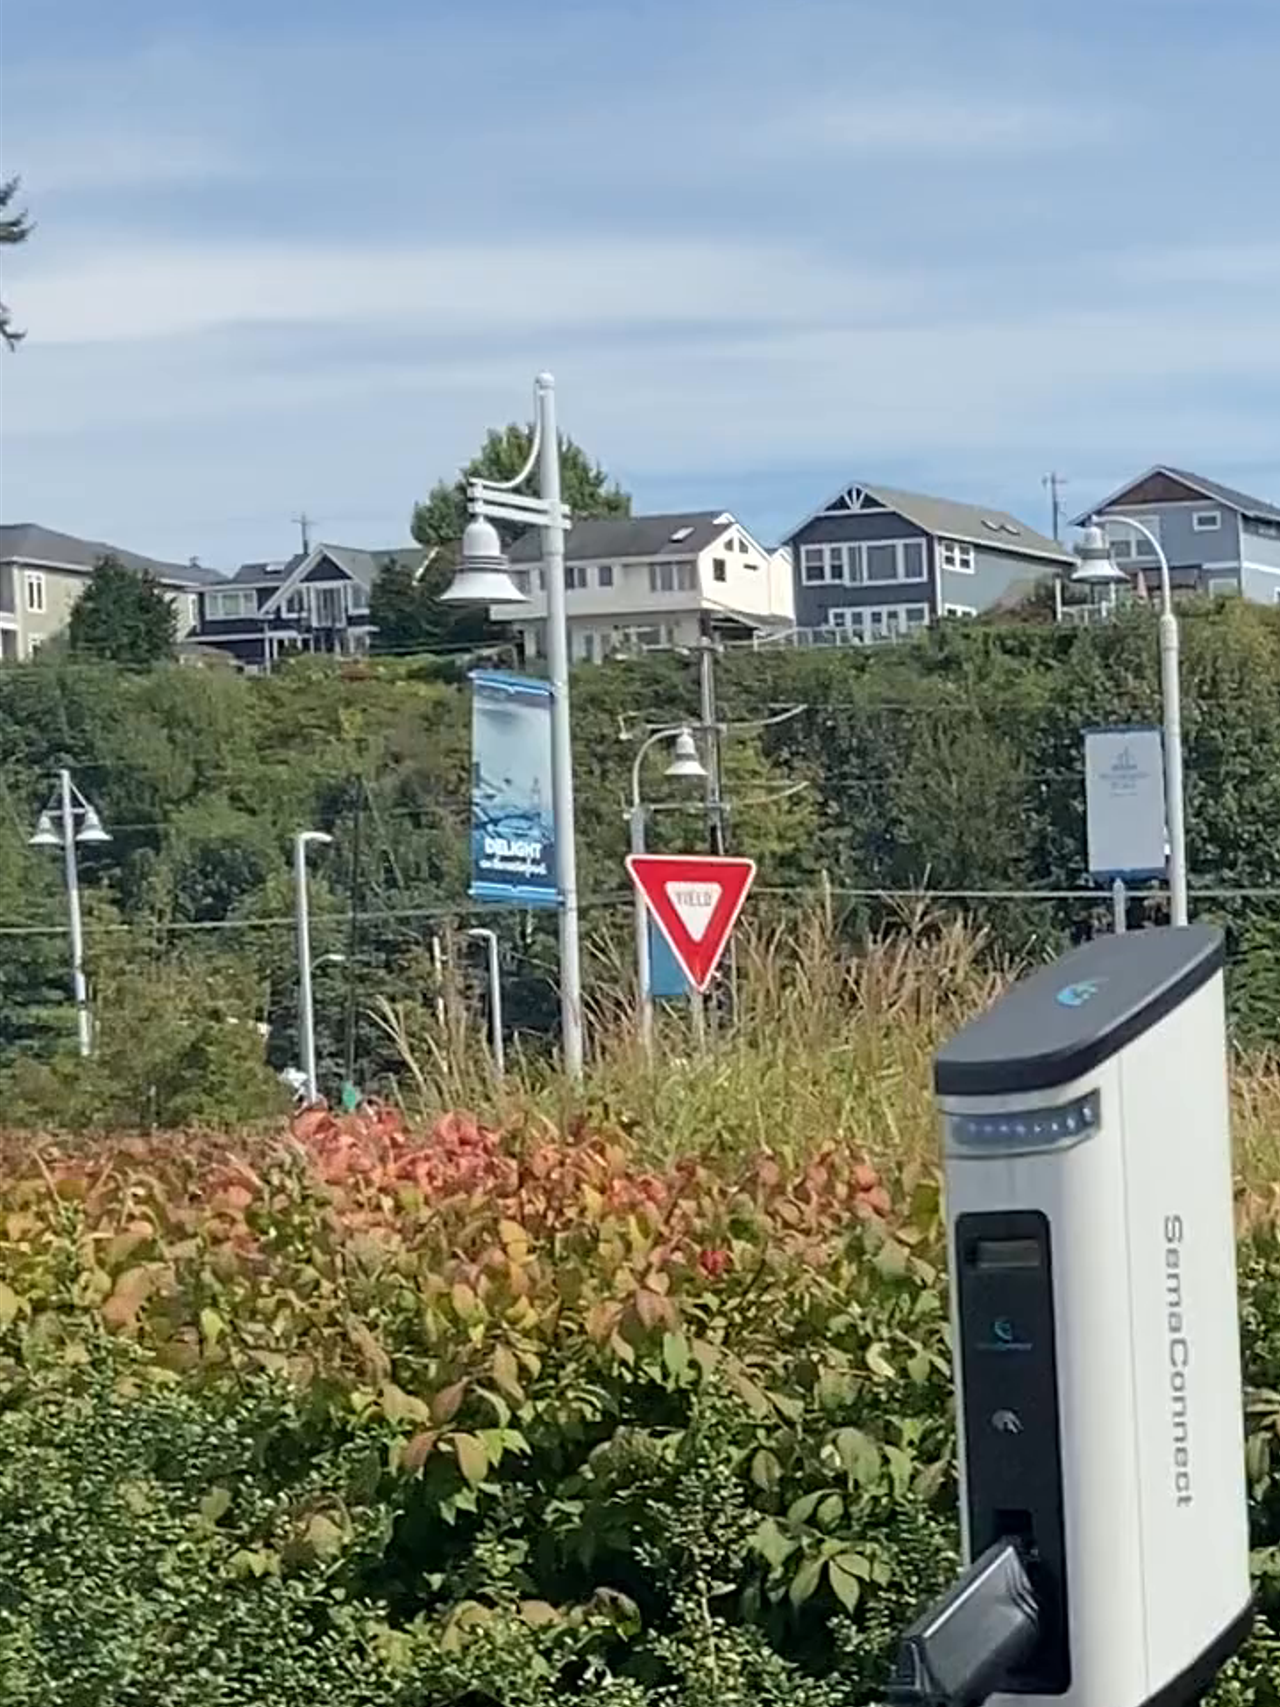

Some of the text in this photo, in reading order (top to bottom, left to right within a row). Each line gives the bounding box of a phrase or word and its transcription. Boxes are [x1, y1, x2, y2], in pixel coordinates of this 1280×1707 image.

[485, 837, 542, 859] DELIGHT
[675, 890, 712, 907] YIELD
[1163, 1214, 1193, 1508] SemaConnect
